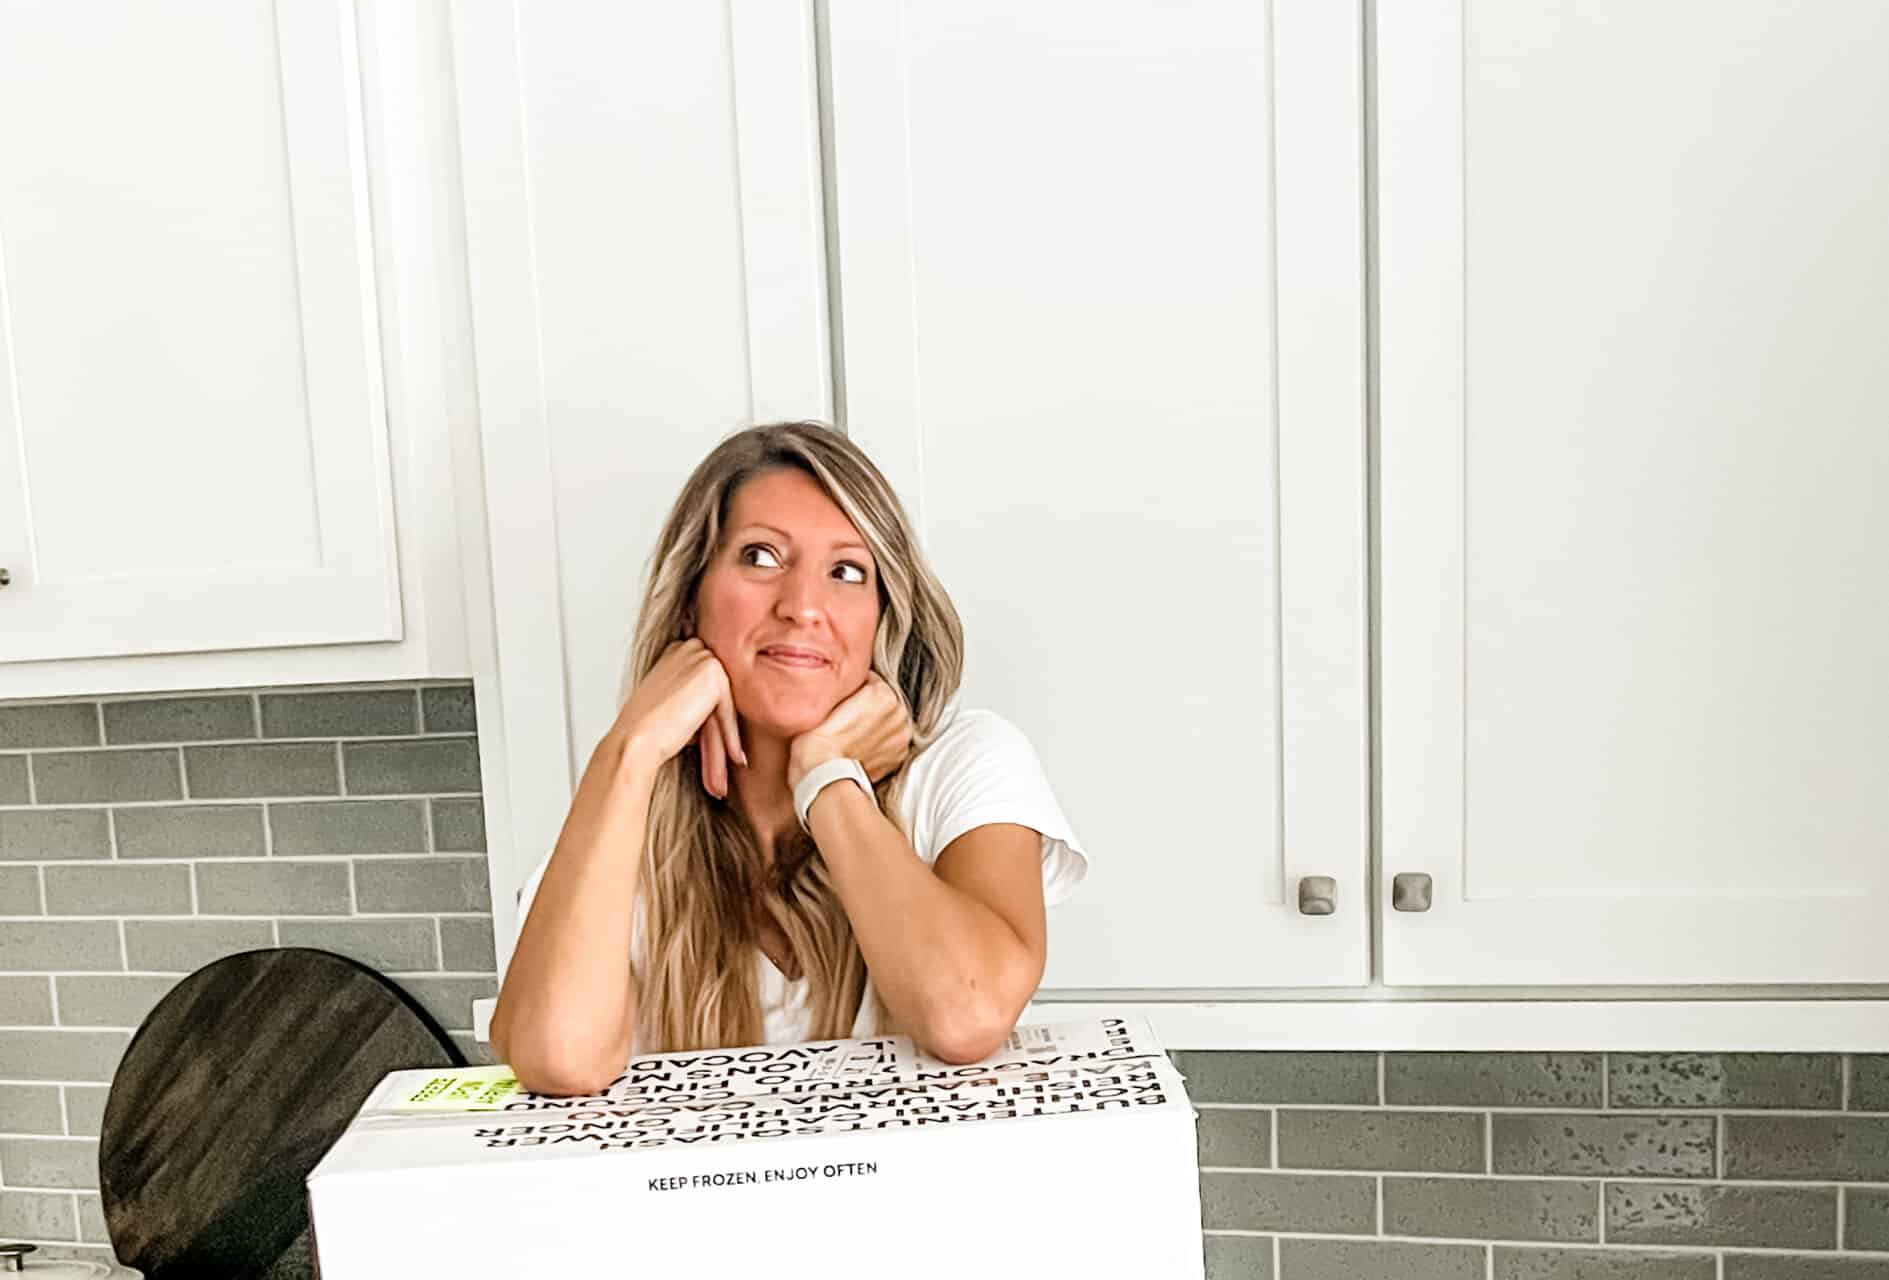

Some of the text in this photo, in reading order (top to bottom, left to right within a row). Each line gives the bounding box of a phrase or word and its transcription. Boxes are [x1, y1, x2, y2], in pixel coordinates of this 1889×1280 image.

[626, 1044, 839, 1071] AVOCAD
[917, 1046, 1134, 1081] DRAGON
[475, 1071, 1156, 1138] REISHI TURMERIC GINGER
[567, 1061, 1151, 1121] KALE BANANA CACAO
[752, 1076, 900, 1096] FRUIT
[486, 1082, 1161, 1148] KOHLRABI CAULIFLOWER
[600, 1094, 1167, 1150] BUTTERNUT SQUASH
[648, 1176, 688, 1191] KEEP
[764, 1166, 819, 1182] ENJOY
[823, 1162, 878, 1178] OFTEN
